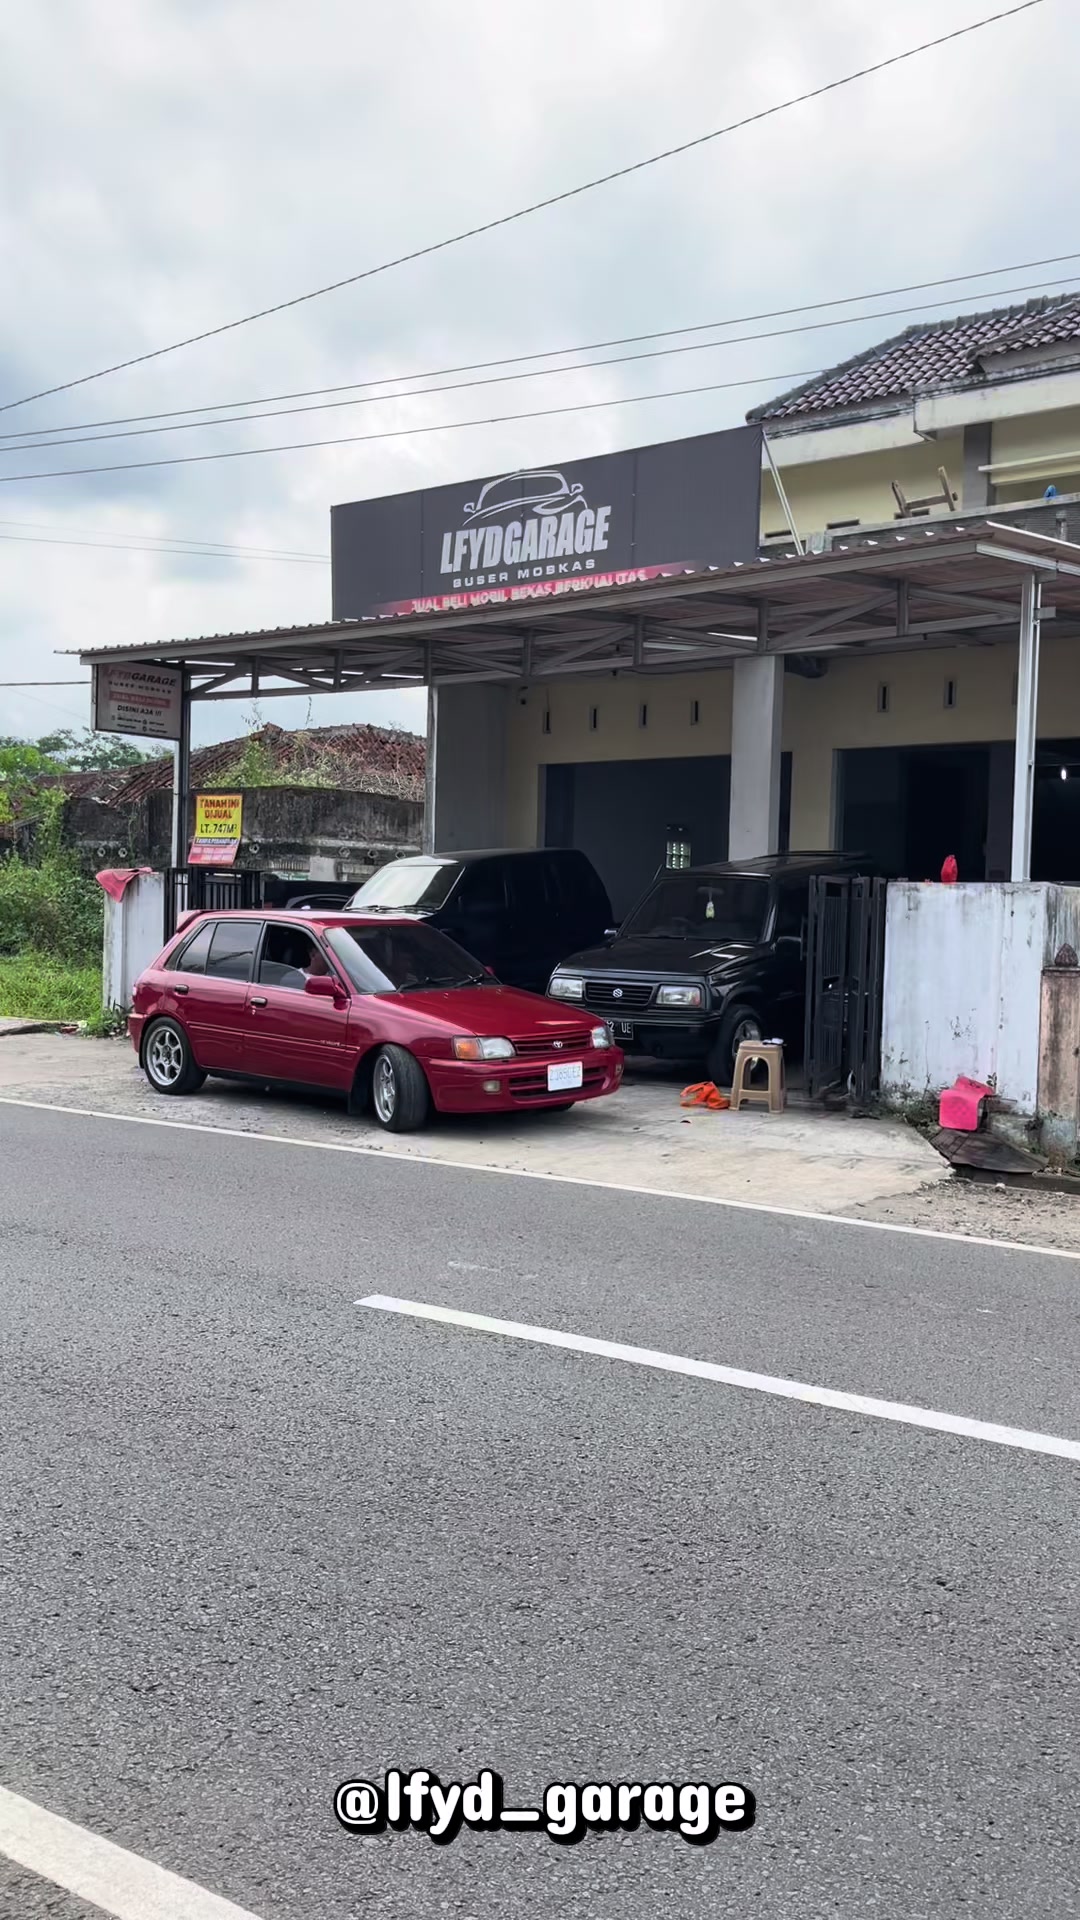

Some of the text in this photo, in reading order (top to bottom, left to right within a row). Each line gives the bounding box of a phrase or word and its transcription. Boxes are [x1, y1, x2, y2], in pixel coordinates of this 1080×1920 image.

[440, 505, 612, 575] LFYDGARAGE
[453, 559, 596, 588] BUSER MOBKAS
[412, 598, 441, 613] JUAL
[442, 593, 468, 609] BELI
[469, 588, 506, 606] MOBIL
[511, 581, 553, 600] BEKAS
[200, 799, 227, 808] TANAH
[205, 810, 232, 819] DIJUAL
